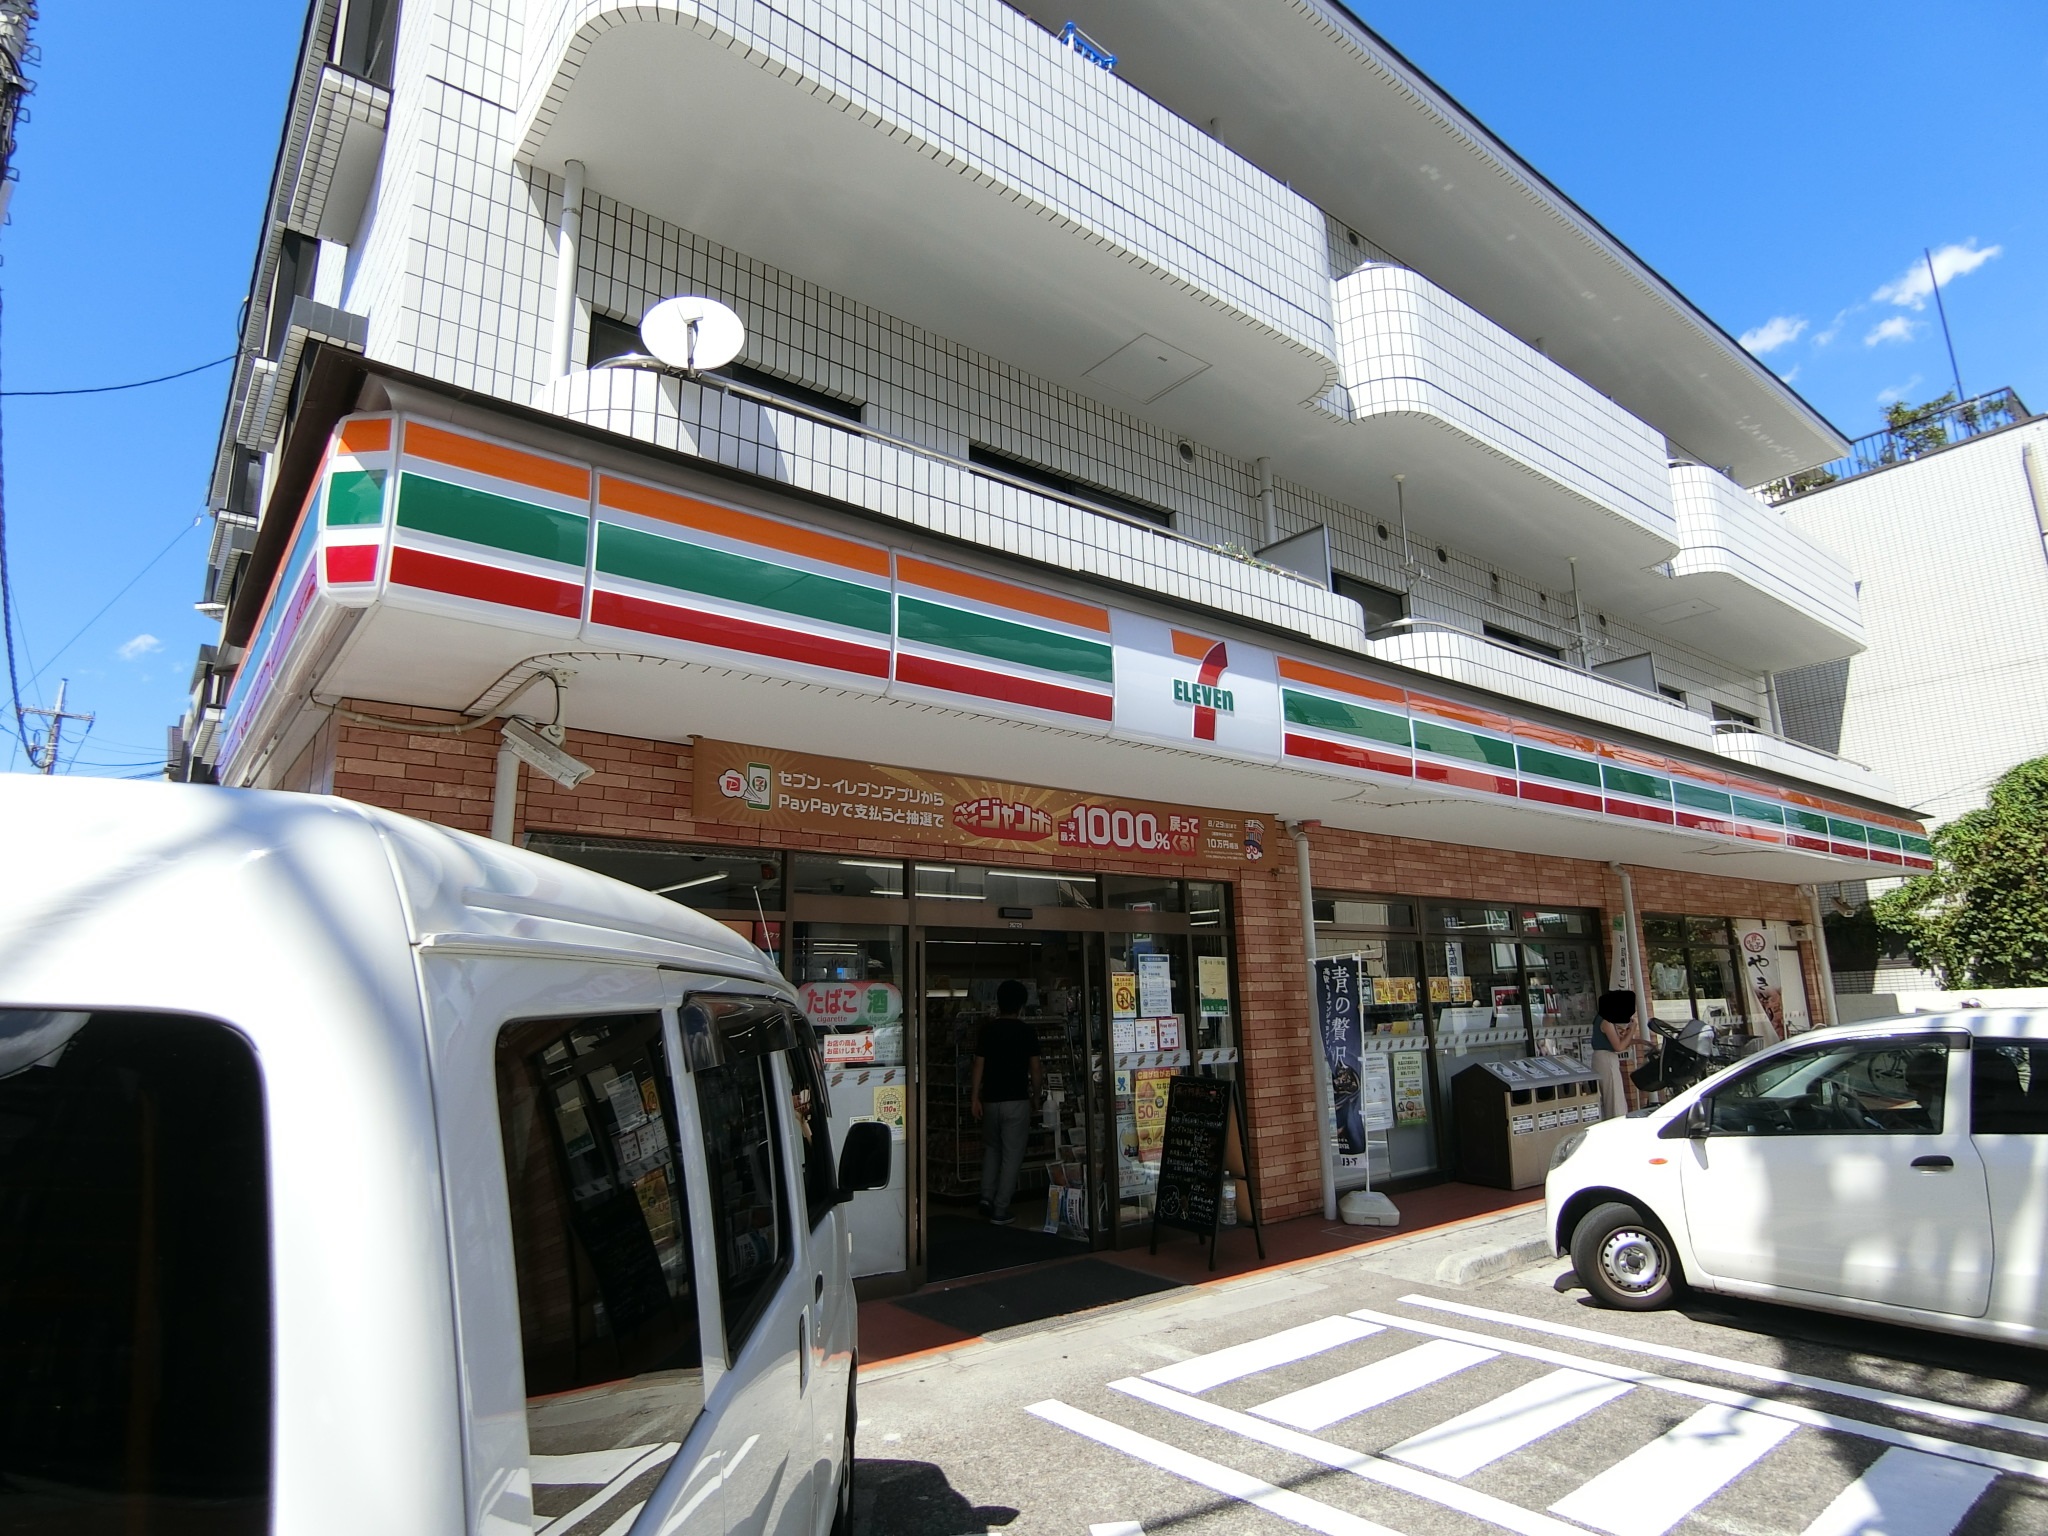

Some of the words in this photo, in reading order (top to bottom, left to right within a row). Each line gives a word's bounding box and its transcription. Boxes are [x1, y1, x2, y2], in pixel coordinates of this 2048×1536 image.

[778, 793, 944, 828] PayPayで支払うと抽選で
[980, 799, 1051, 834] ジャンボ
[1060, 832, 1077, 842] 最大
[1073, 805, 1170, 850] 1000%
[1169, 815, 1199, 834] 戻って
[1172, 834, 1195, 852] くる!
[806, 988, 857, 1014] たばこ
[867, 989, 888, 1014] 酒
[816, 1015, 847, 1024] cigarette
[1331, 965, 1350, 1069] 青の贅沢
[827, 1039, 857, 1047] お店の商品
